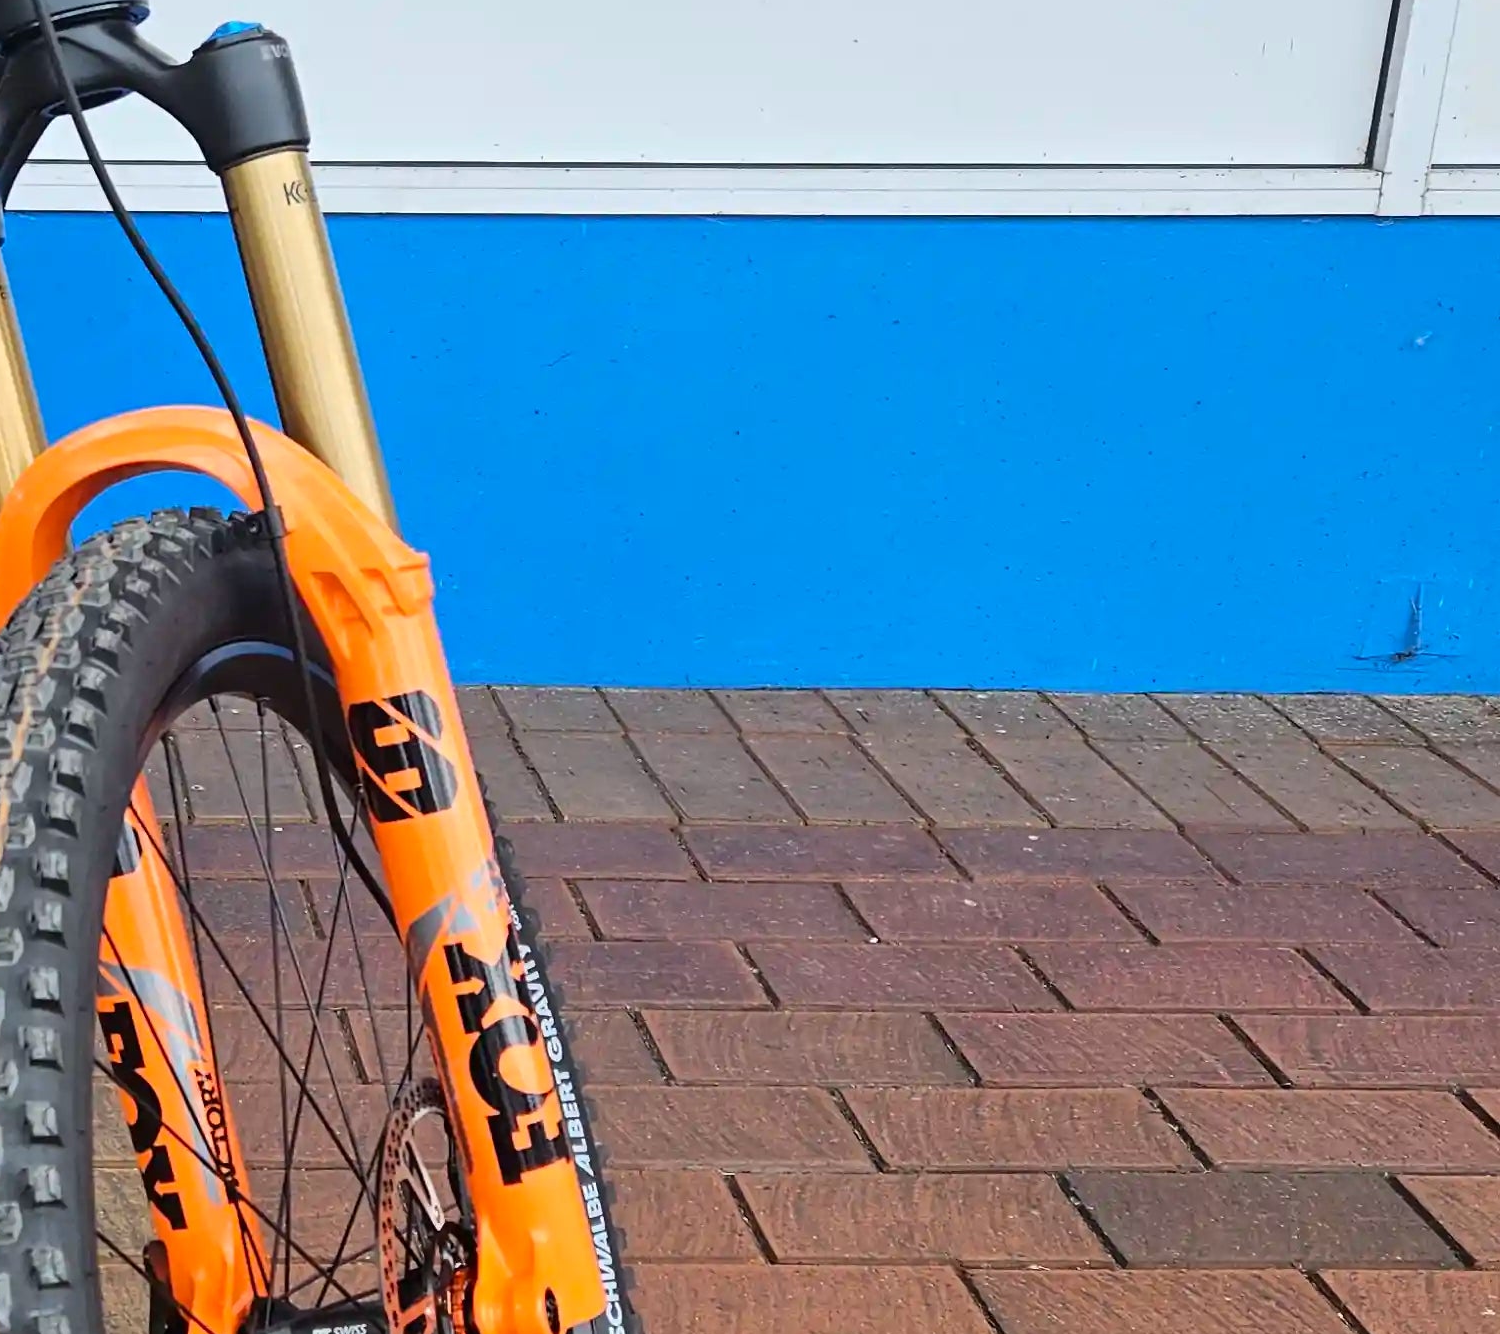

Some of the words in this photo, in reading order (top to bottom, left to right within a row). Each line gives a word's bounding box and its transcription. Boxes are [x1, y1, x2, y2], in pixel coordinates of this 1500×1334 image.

[518, 943, 564, 1063] GRAVITY
[444, 942, 573, 1186] FOX
[553, 1068, 596, 1178] ALBERT
